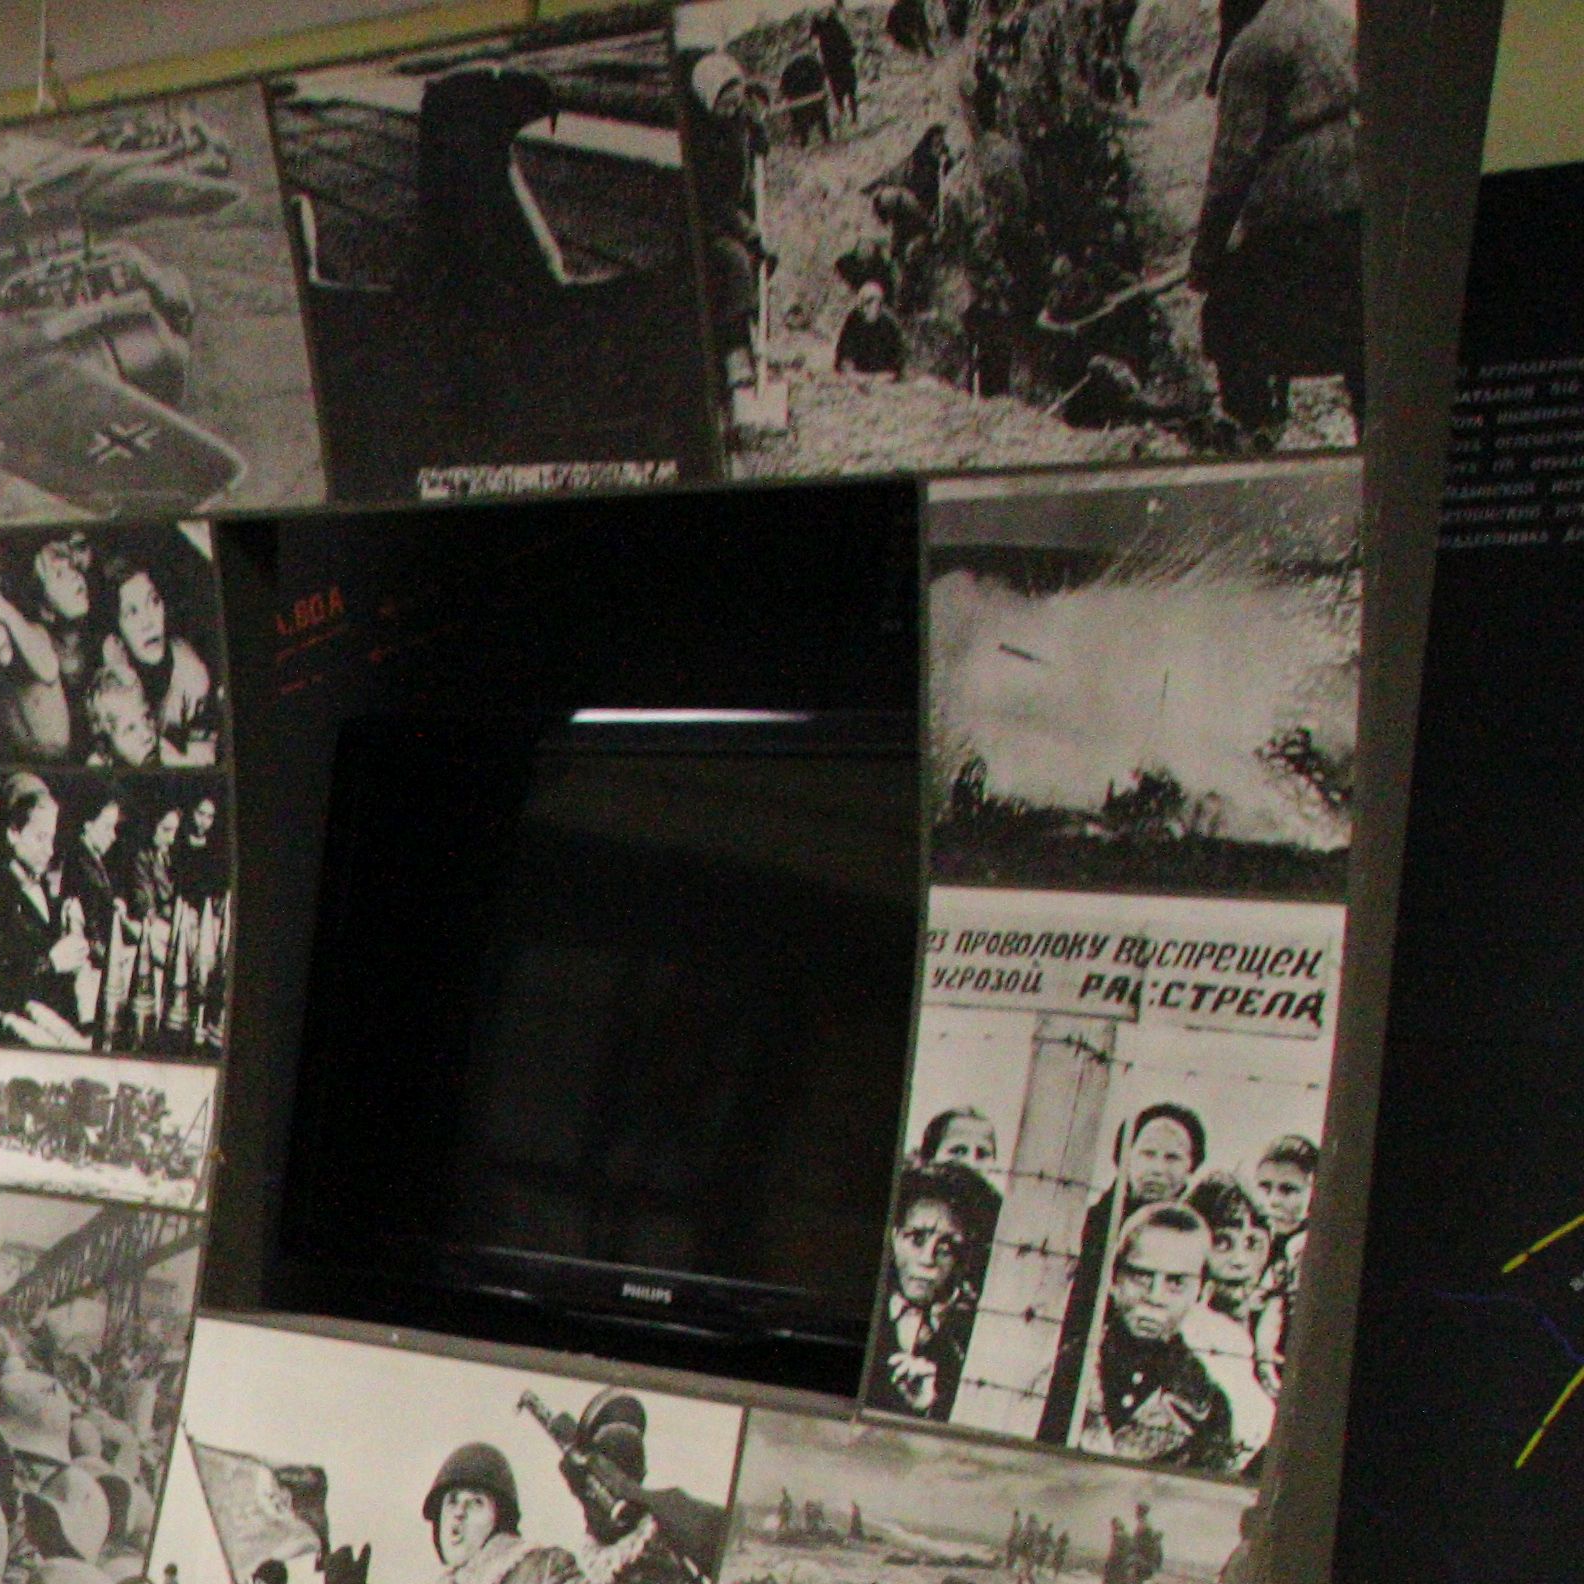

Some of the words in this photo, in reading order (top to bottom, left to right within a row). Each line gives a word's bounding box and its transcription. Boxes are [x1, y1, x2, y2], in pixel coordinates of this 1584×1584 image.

[955, 928, 1108, 960] ПРОВОЛОКУ
[1113, 936, 1324, 980] ВОСПРЕЩЕН
[932, 963, 1043, 994] УГРОЗОЙ
